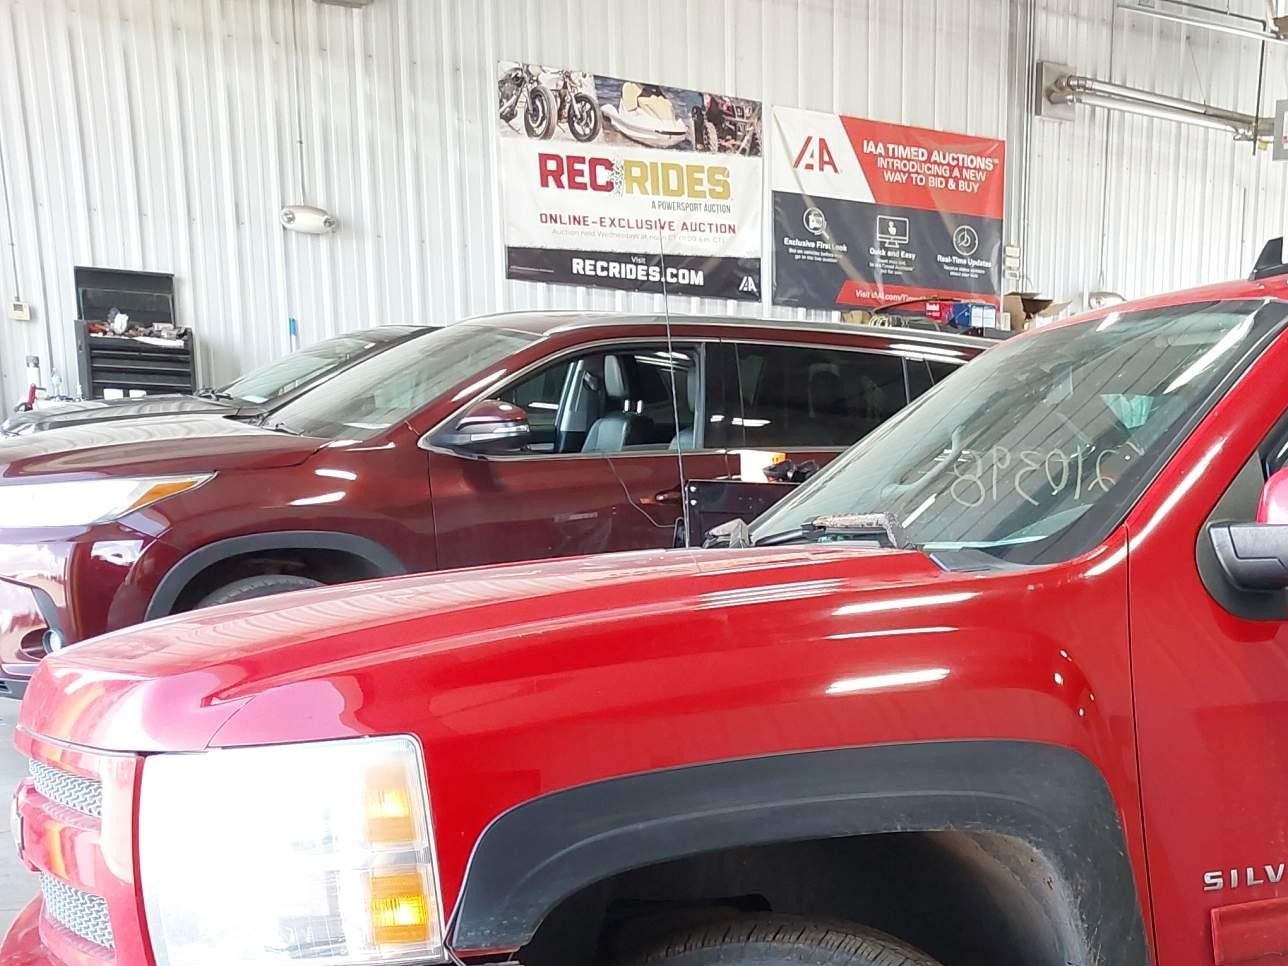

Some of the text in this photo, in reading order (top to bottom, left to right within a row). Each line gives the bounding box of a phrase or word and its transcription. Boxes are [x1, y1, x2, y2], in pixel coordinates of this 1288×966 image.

[863, 140, 885, 156] IAA
[887, 144, 928, 161] TIMED
[538, 152, 732, 200] REC RIDES
[877, 157, 986, 182] INTRODUCING A NEW
[884, 170, 980, 193] WAY TO BID & BUY
[651, 201, 731, 214] A POWERSPORT AUCTION
[539, 212, 736, 234] ONLINE-EXCLUSIVE AUCTION
[784, 237, 815, 248] Exclusive
[816, 241, 831, 250] First
[631, 255, 646, 263] Visit
[869, 247, 916, 260] Quick and Easy
[937, 254, 992, 268] Real-Time Updates
[572, 258, 704, 286] RECRIDES.COM
[855, 289, 870, 298] Visit
